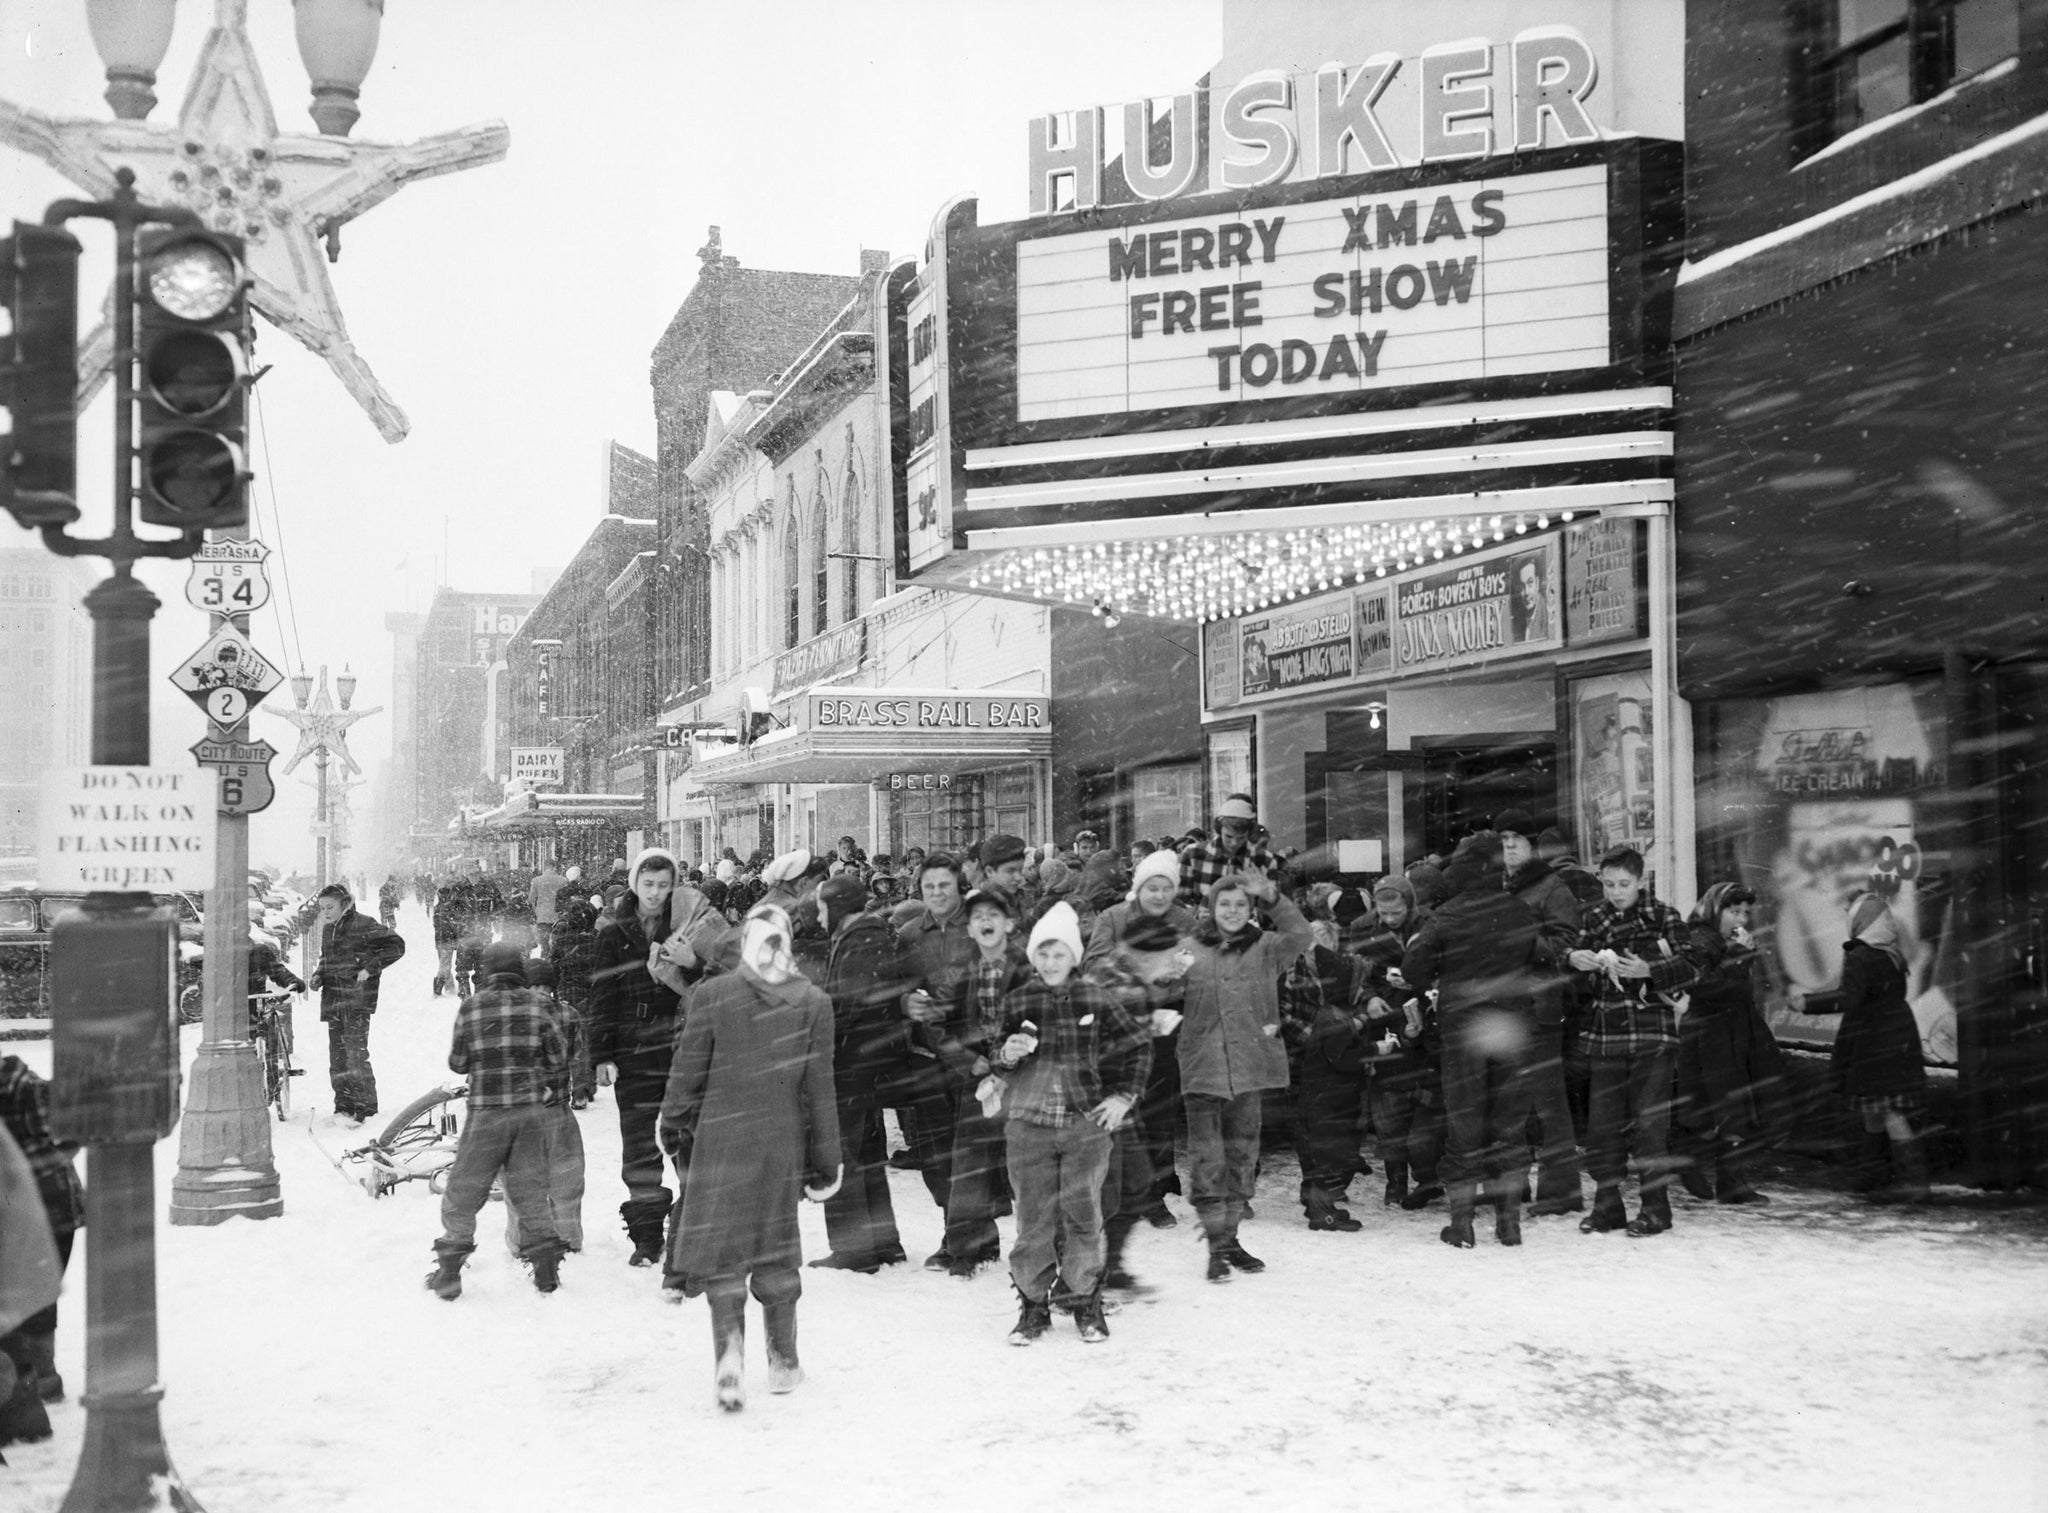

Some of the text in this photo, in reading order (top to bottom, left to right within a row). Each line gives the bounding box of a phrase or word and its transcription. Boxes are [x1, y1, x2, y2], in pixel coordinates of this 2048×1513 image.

[1028, 28, 1599, 218] HUSKER
[1108, 189, 1506, 281] MERRY XMAS
[1130, 255, 1478, 338] FREE SHOW
[1208, 330, 1387, 390] TODAY
[197, 546, 260, 559] NEBRASKA
[203, 578, 253, 606] 34
[1401, 572, 1506, 616] GORCEY BOWERY BOYS
[1362, 596, 1386, 625] NOW
[1272, 621, 1304, 651] ABBOTT
[1309, 612, 1349, 641] COSTELLO
[1401, 599, 1507, 663] JINX MONEY
[539, 653, 548, 714] CAFE
[221, 693, 232, 717] 2
[820, 700, 1041, 728] BRASS RAIL BAR
[667, 728, 692, 746] CA
[201, 746, 267, 760] CITY ROUTE
[517, 754, 558, 766] DAIRY
[82, 772, 183, 790] DO NOT
[222, 778, 243, 806] 6
[890, 773, 950, 790] BEER
[69, 804, 195, 821] WALK ON
[577, 818, 596, 826] RADIO
[58, 836, 201, 852] FLASHING
[81, 867, 176, 887] GREEN
